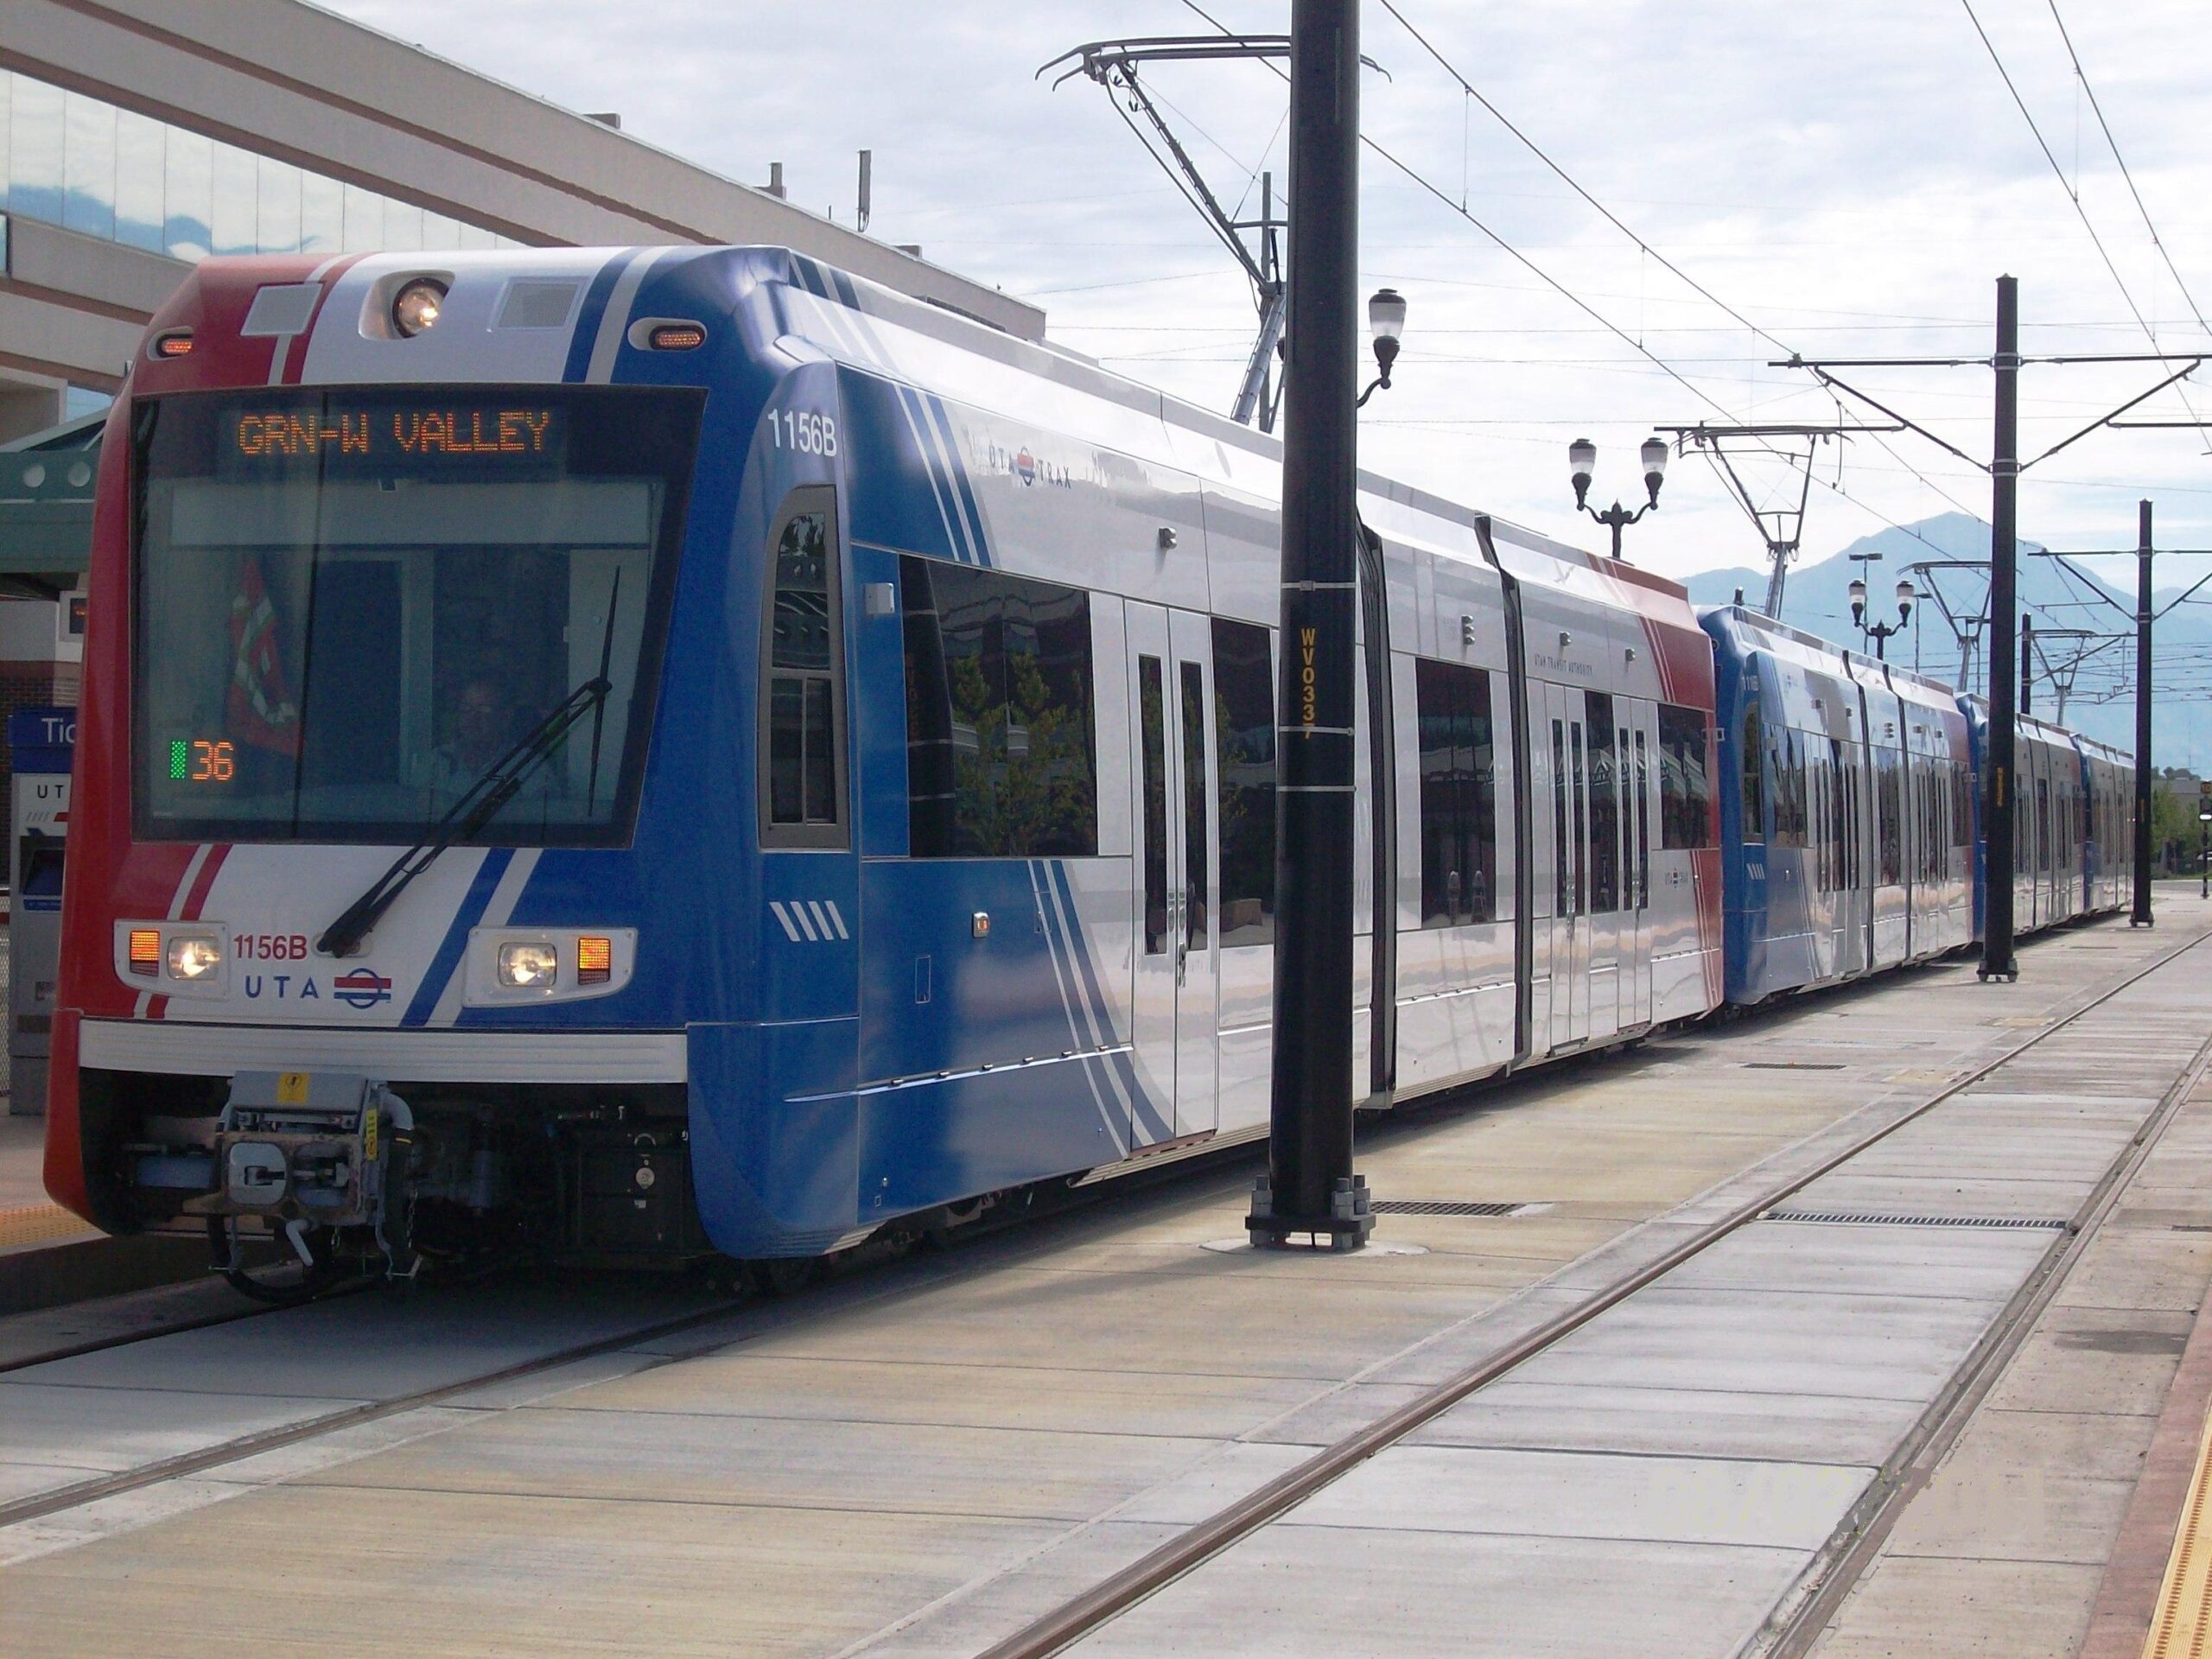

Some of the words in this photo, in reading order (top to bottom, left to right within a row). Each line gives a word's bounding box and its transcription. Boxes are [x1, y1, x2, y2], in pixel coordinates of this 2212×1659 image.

[238, 414, 369, 454] GRN-W
[394, 411, 550, 453] VALLEY
[767, 408, 837, 457] 1156B
[988, 444, 1015, 474] UTA
[1036, 458, 1071, 489] TRAX
[192, 740, 235, 781] 36
[233, 934, 308, 961] 1156B
[245, 975, 320, 1000] UTA
